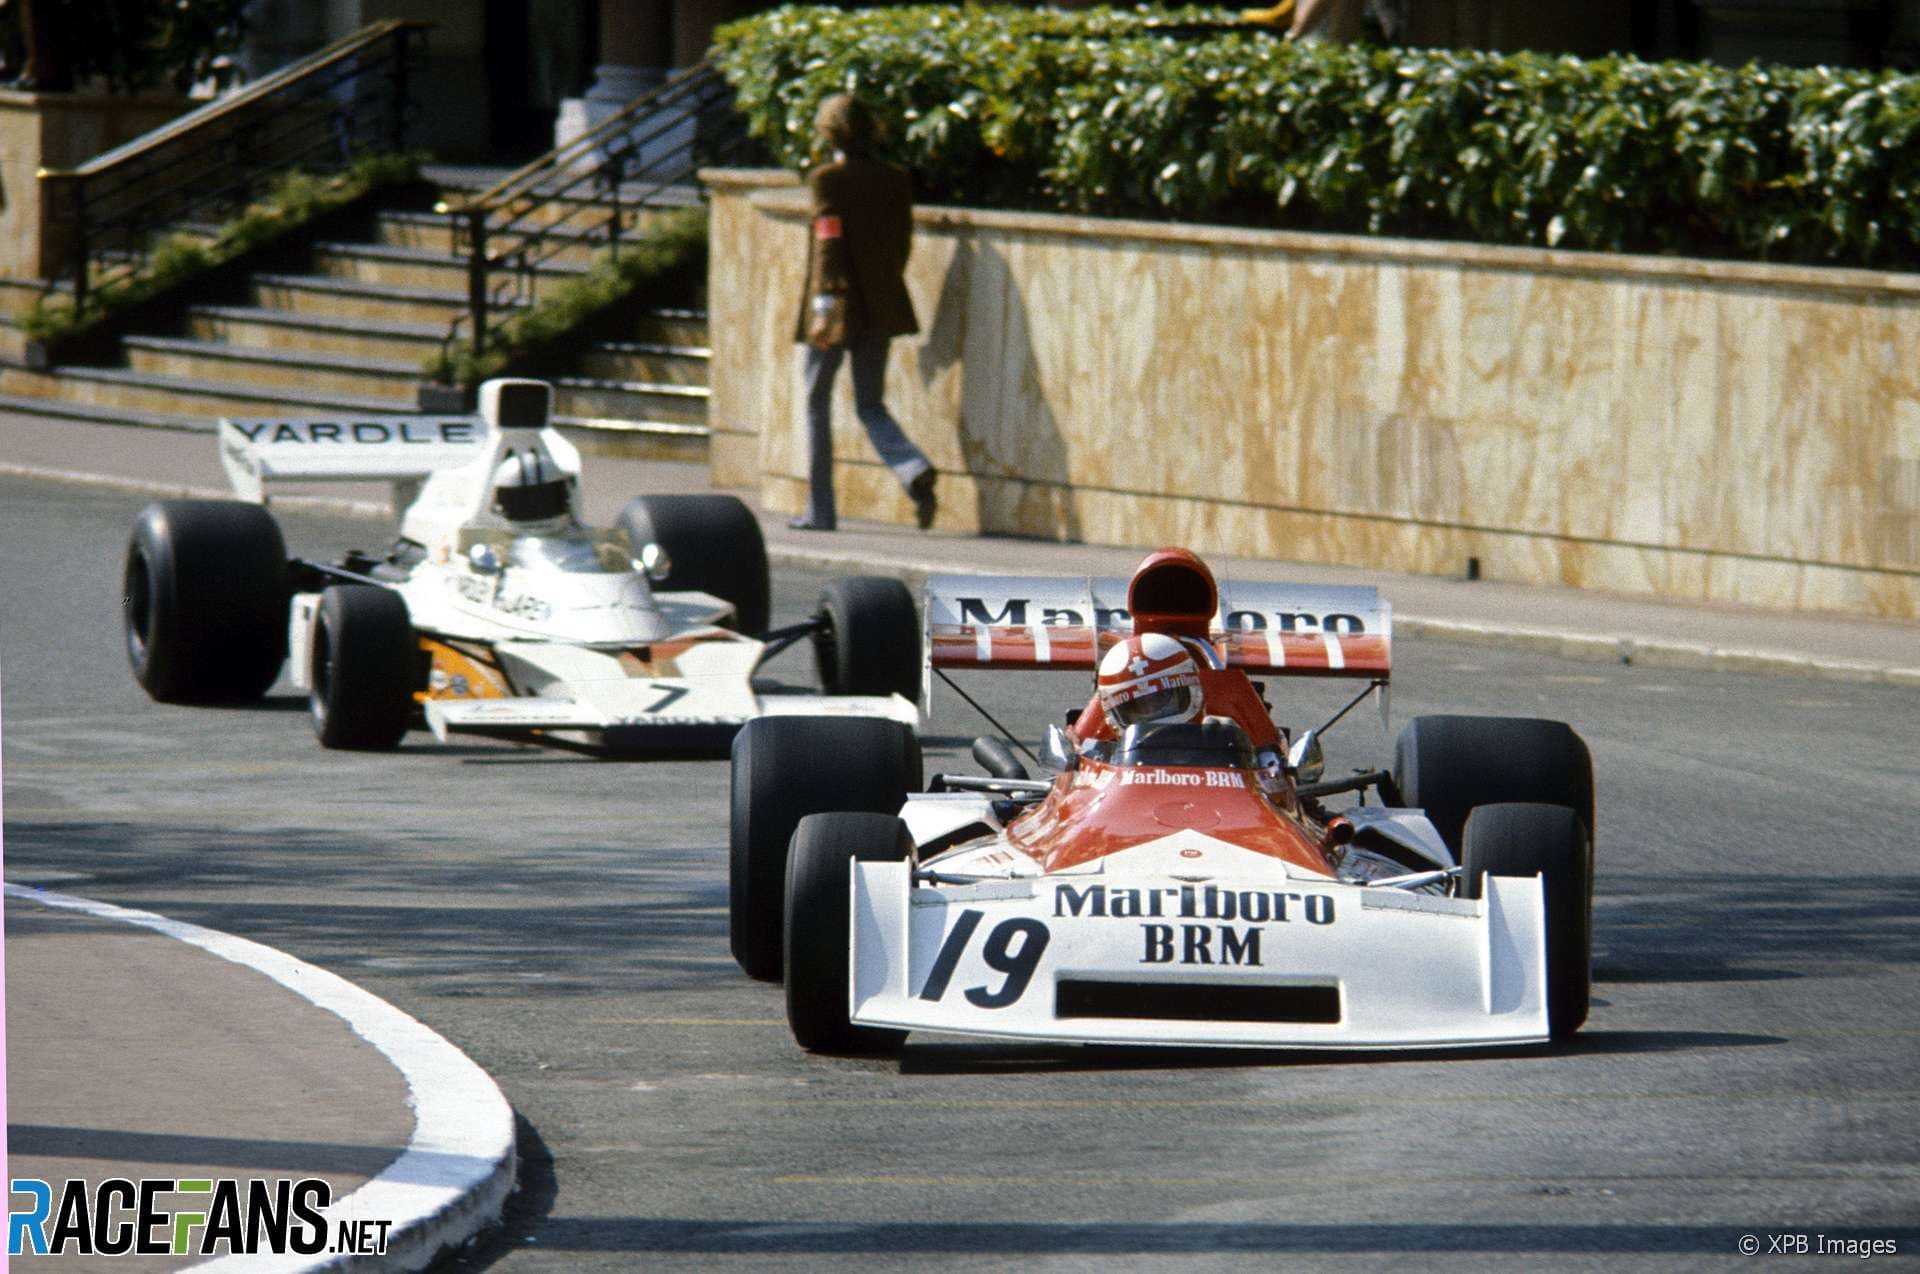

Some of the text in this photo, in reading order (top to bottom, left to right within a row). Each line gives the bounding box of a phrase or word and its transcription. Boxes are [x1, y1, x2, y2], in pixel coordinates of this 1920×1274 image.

[643, 683, 690, 713] 7
[1052, 884, 1336, 925] Marlboro
[918, 909, 1051, 1010] 19
[1139, 923, 1265, 967] BRM
